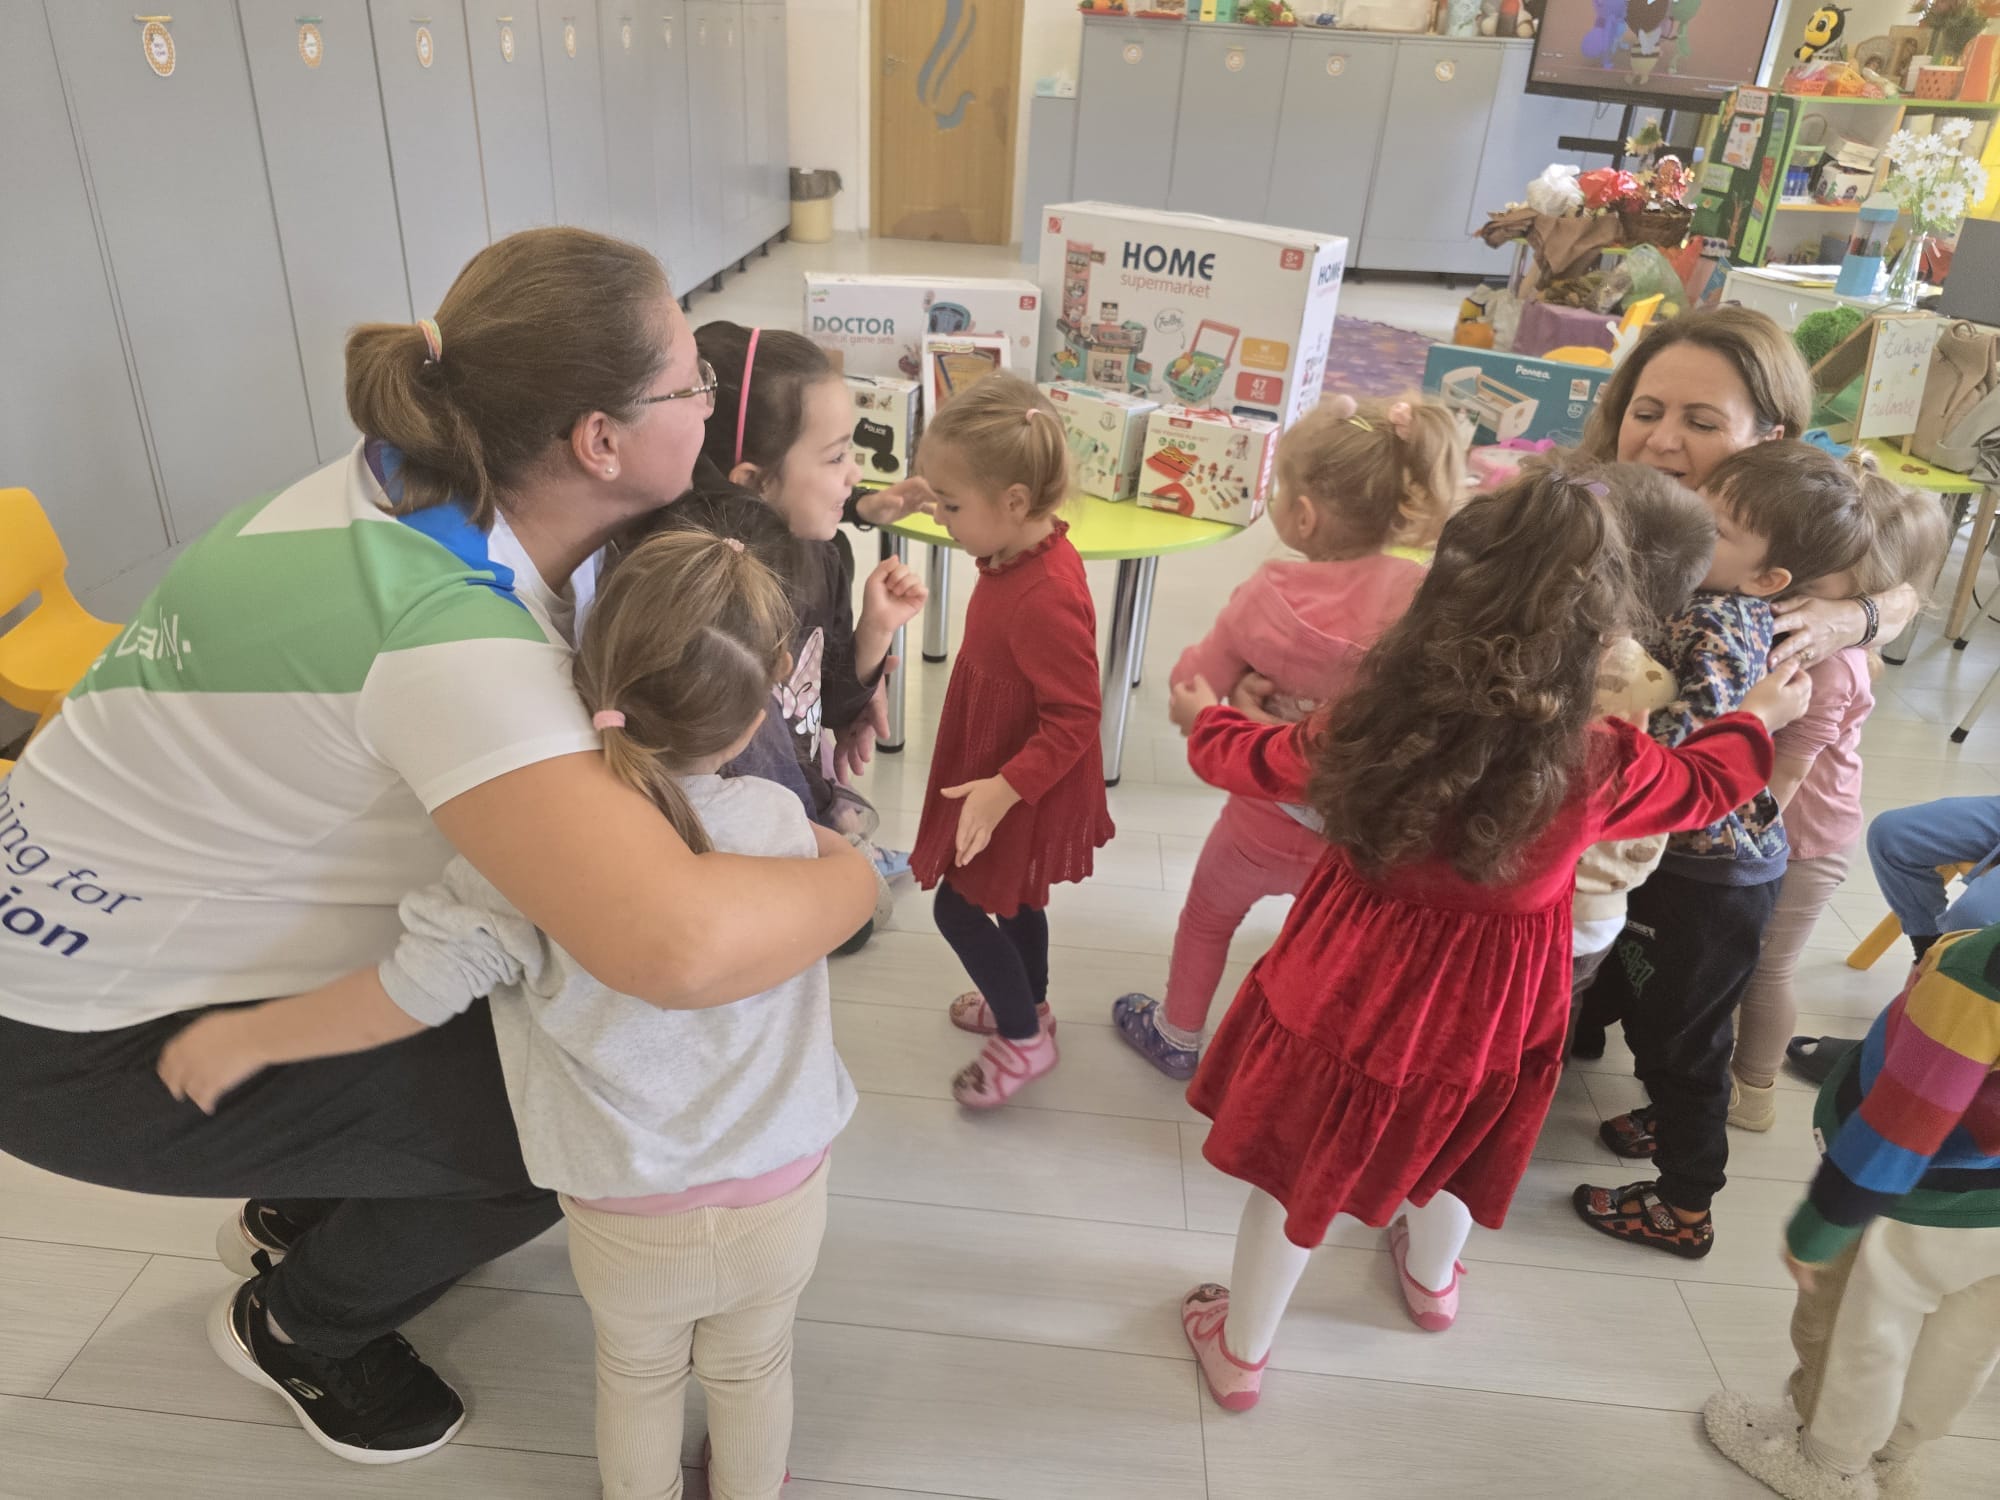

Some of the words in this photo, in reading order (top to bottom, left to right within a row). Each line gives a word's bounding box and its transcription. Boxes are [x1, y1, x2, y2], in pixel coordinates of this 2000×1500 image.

[1122, 241, 1216, 281] HOME
[1120, 273, 1211, 299] supermarket
[812, 315, 895, 335] DOCTOR
[864, 423, 887, 436] POLICE
[47, 868, 143, 915] for
